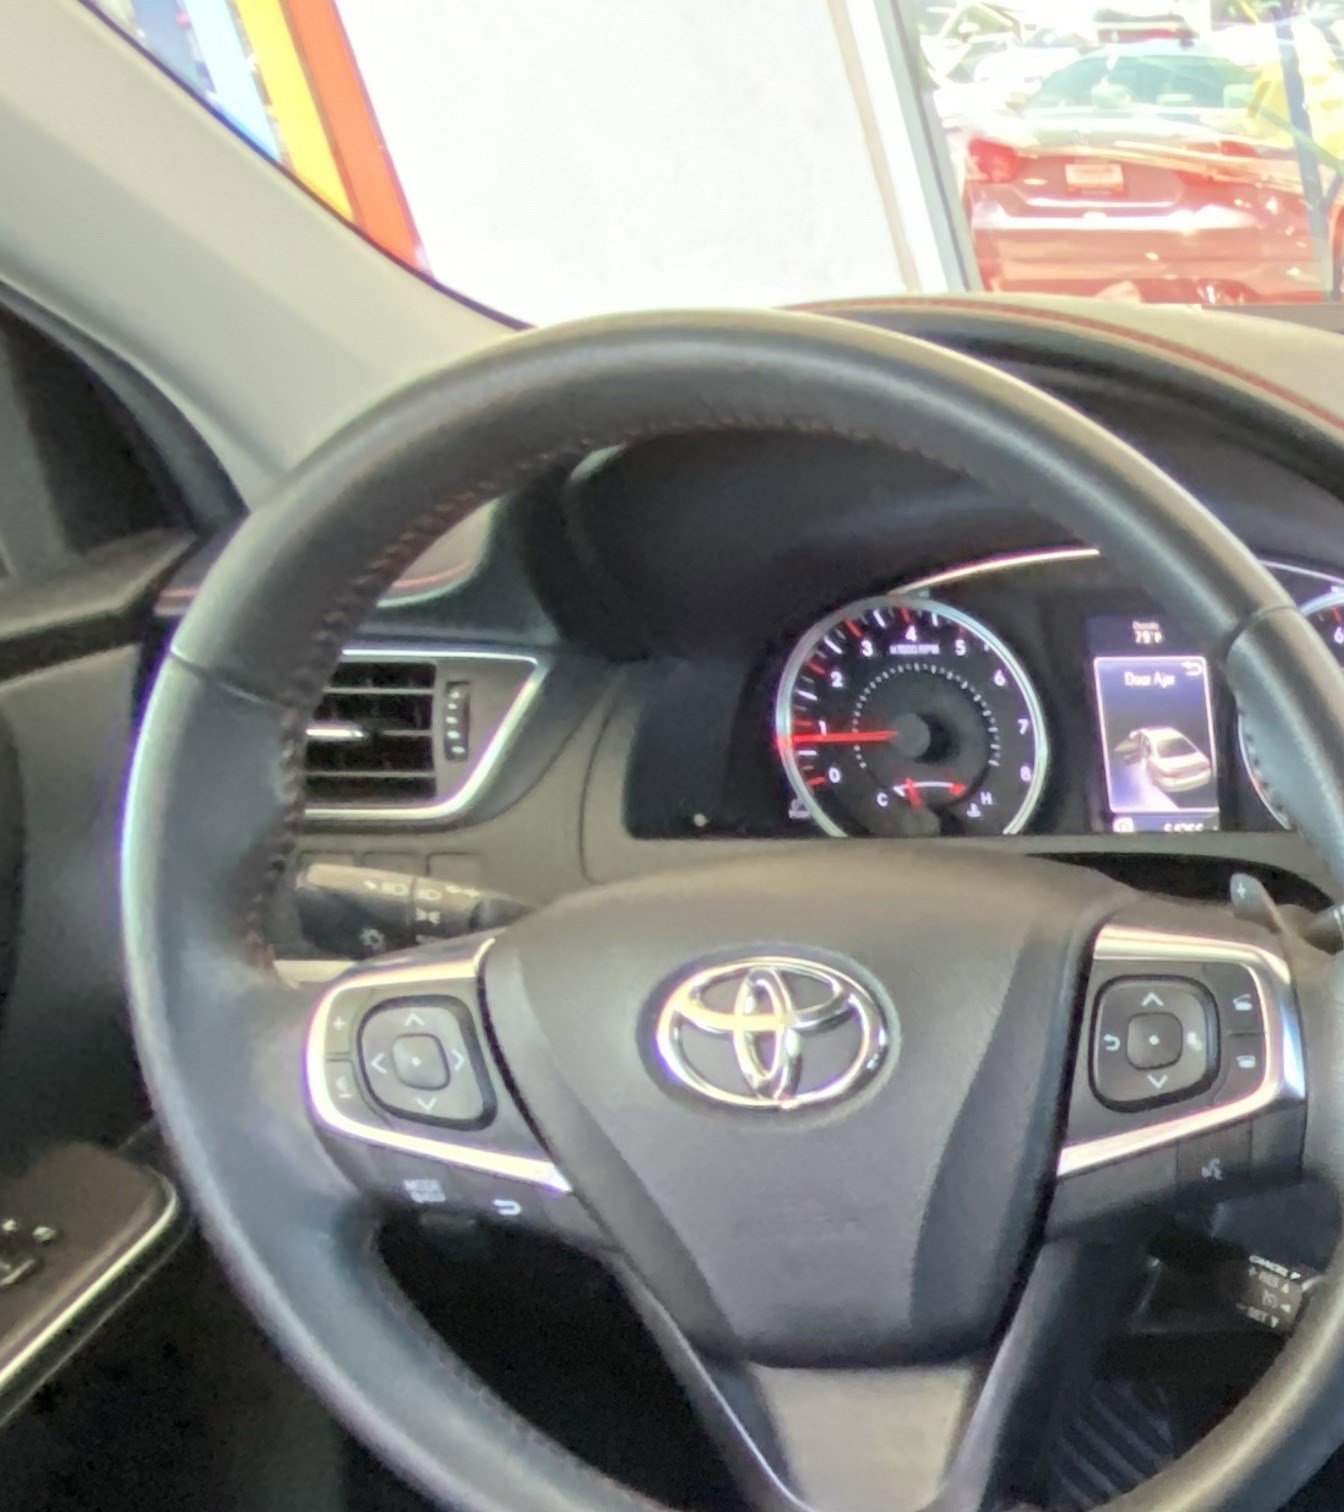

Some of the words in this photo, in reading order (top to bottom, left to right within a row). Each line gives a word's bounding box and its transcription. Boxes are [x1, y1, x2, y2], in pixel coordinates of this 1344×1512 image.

[906, 625, 917, 642] 4
[862, 641, 873, 656] 3
[955, 640, 966, 656] 5
[831, 671, 843, 688] 2
[994, 670, 1006, 686] 6
[818, 720, 827, 736] 1
[1017, 719, 1029, 735] 7
[829, 767, 841, 783] 0
[1020, 766, 1032, 782] 8
[877, 792, 888, 807] C
[980, 791, 993, 806] H
